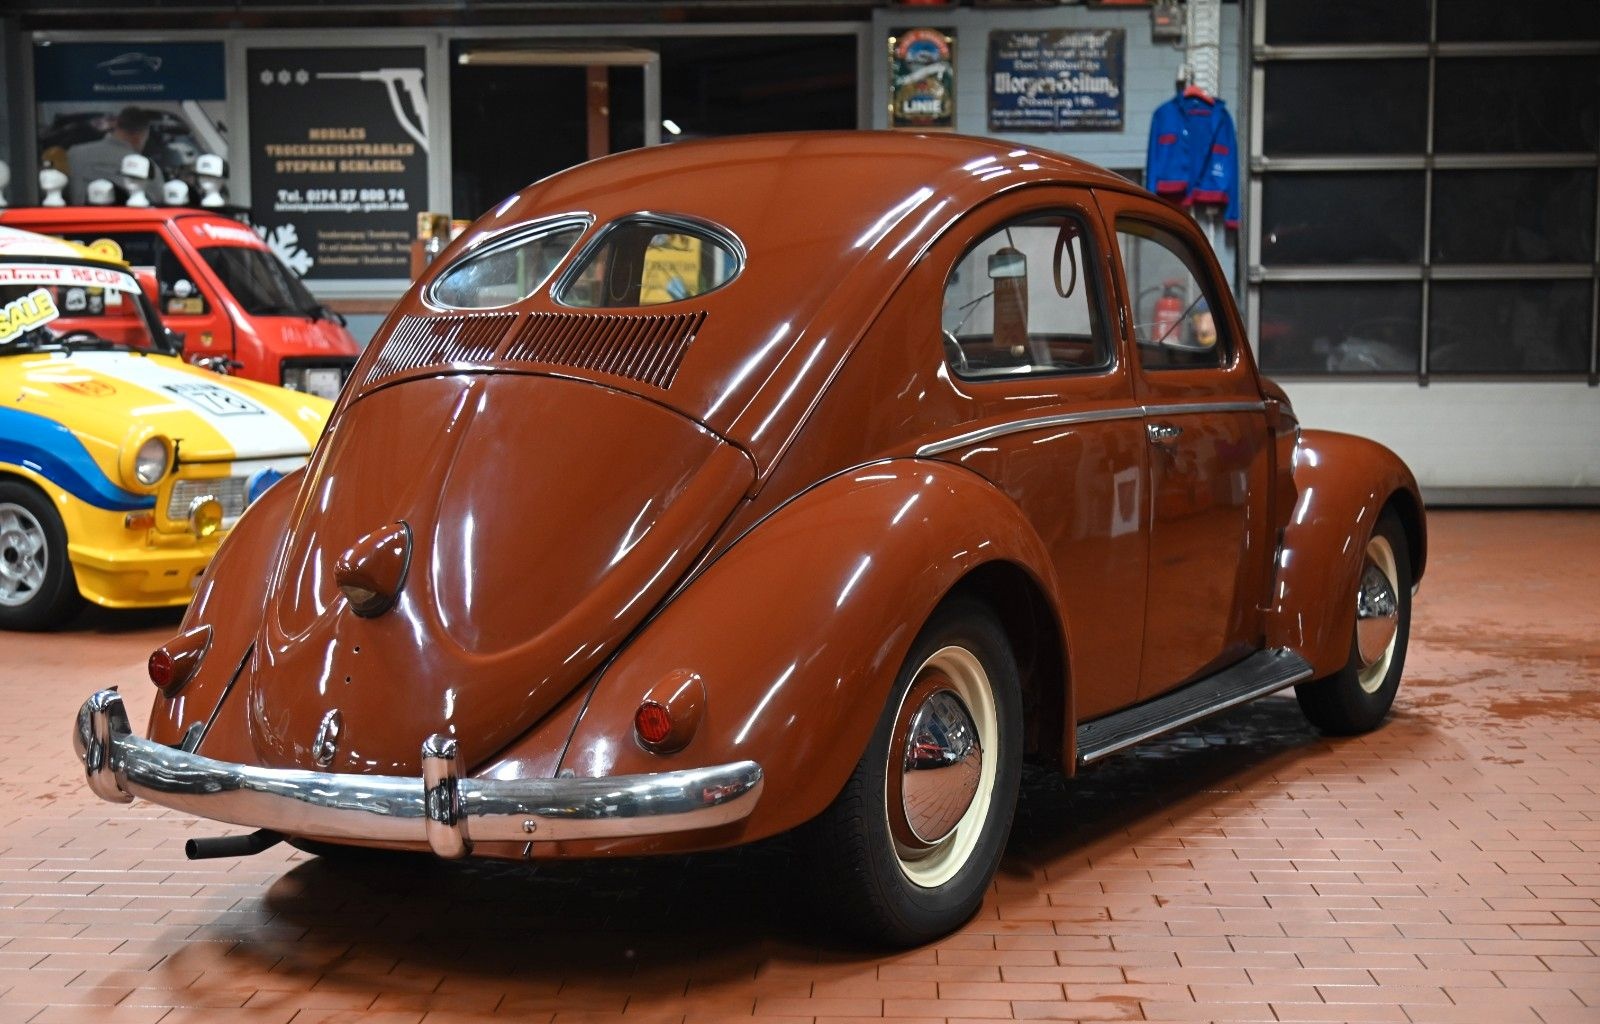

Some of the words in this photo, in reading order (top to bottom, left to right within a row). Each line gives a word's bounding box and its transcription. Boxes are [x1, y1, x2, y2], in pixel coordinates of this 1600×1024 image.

[903, 99, 942, 113] LINIE
[308, 127, 366, 141] MOBILES
[275, 159, 336, 173] STEPHAN
[277, 188, 304, 202] Tel.
[305, 188, 337, 202] 0174
[71, 269, 93, 282] RS
[95, 270, 121, 284] CUP
[0, 292, 56, 339] SALE
